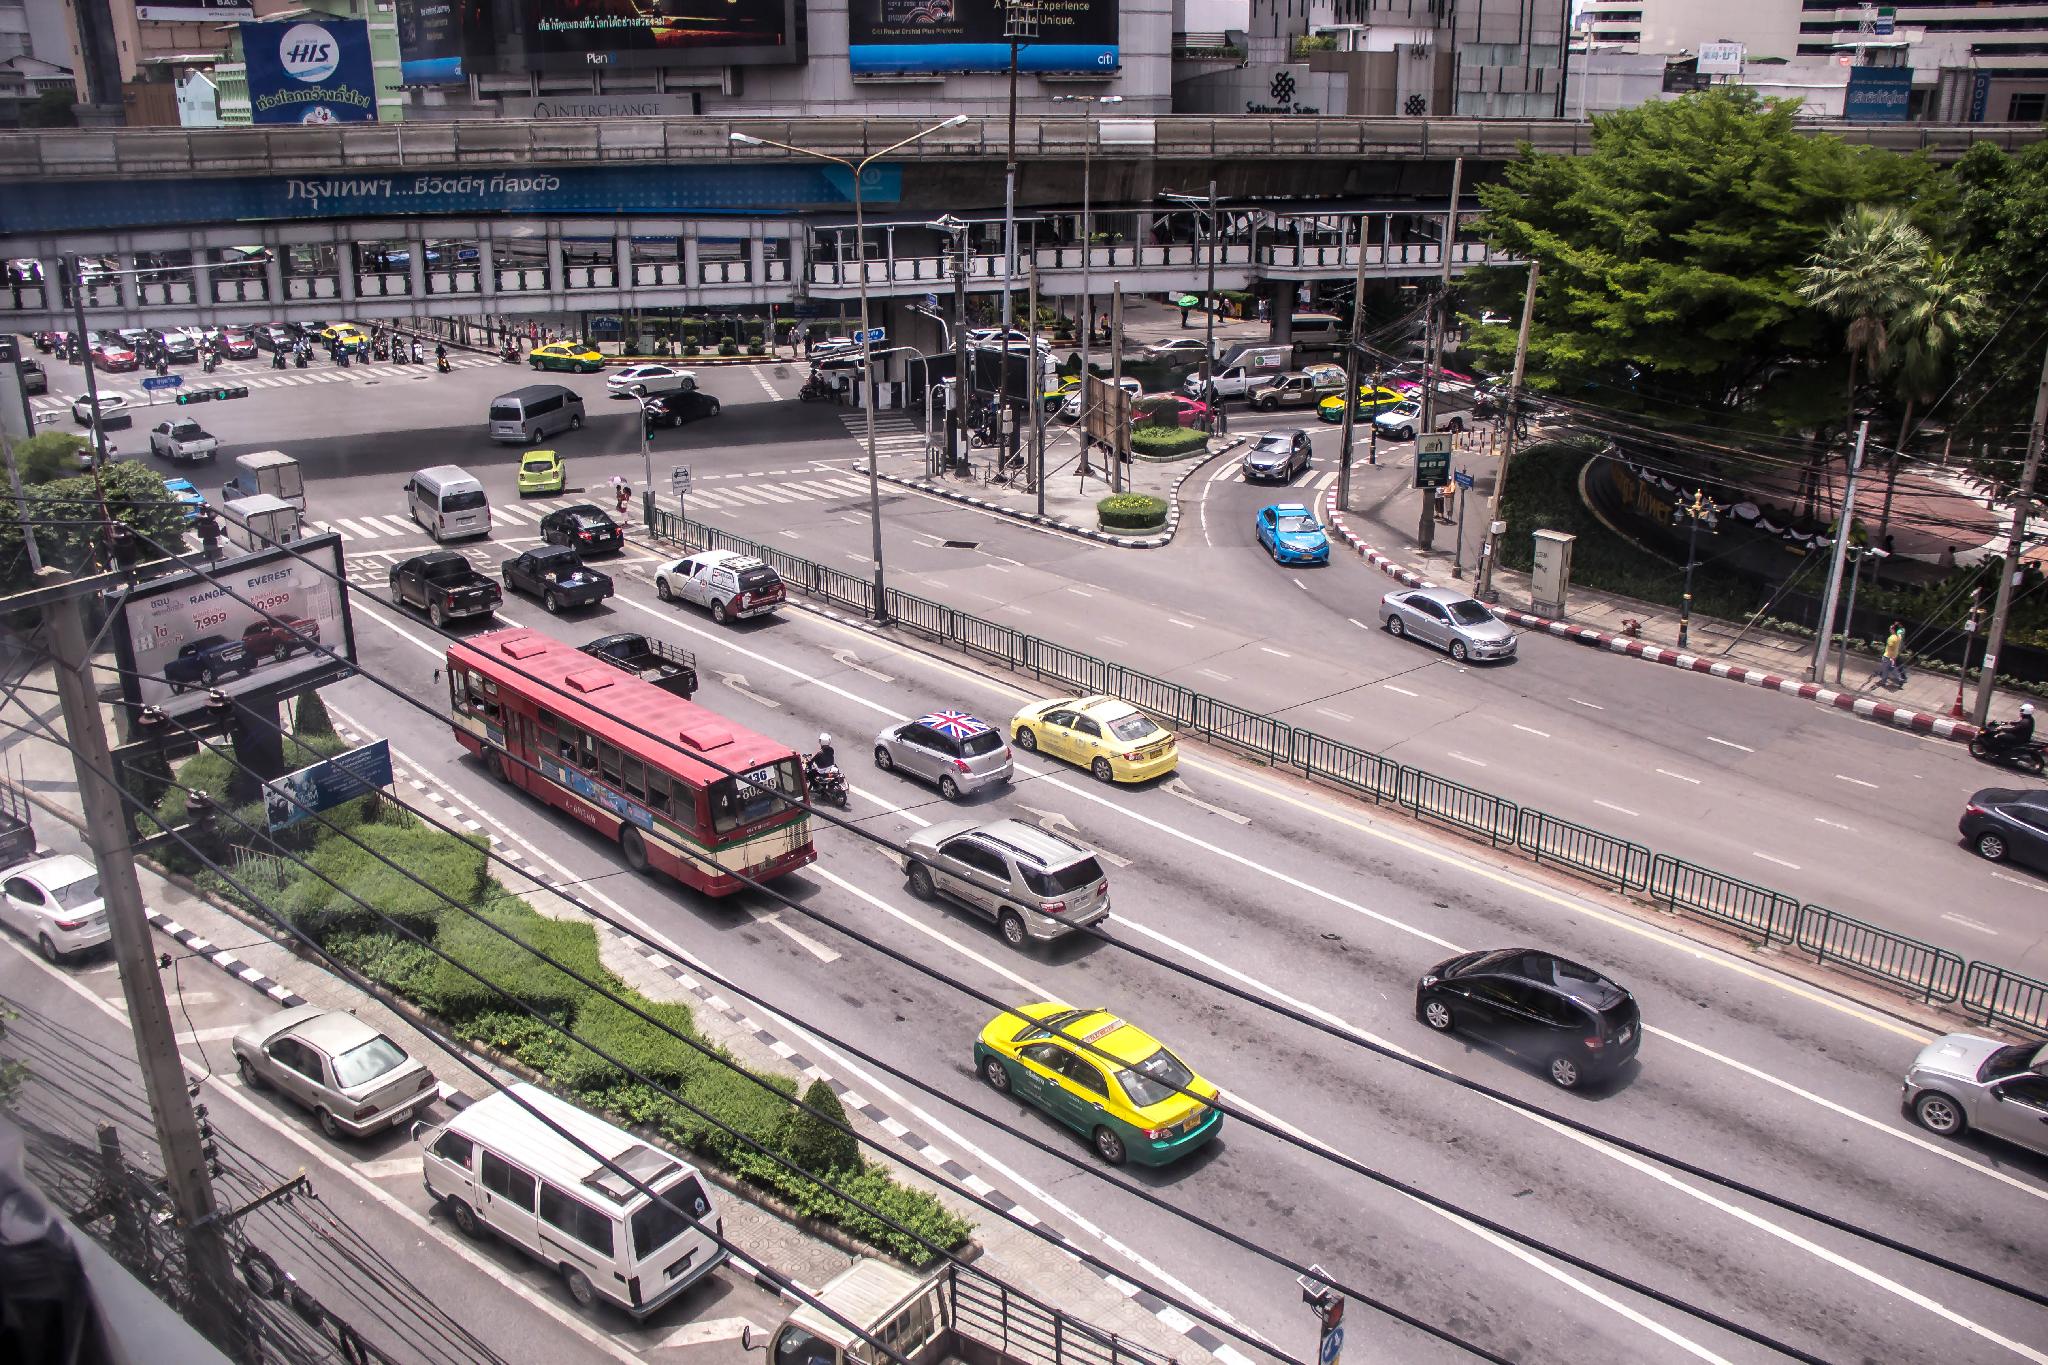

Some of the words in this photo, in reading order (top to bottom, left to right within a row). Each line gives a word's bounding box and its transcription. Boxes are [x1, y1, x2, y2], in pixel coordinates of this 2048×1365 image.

[586, 53, 608, 64] Plan
[247, 567, 293, 588] EVEREST
[194, 612, 228, 631] 7,999
